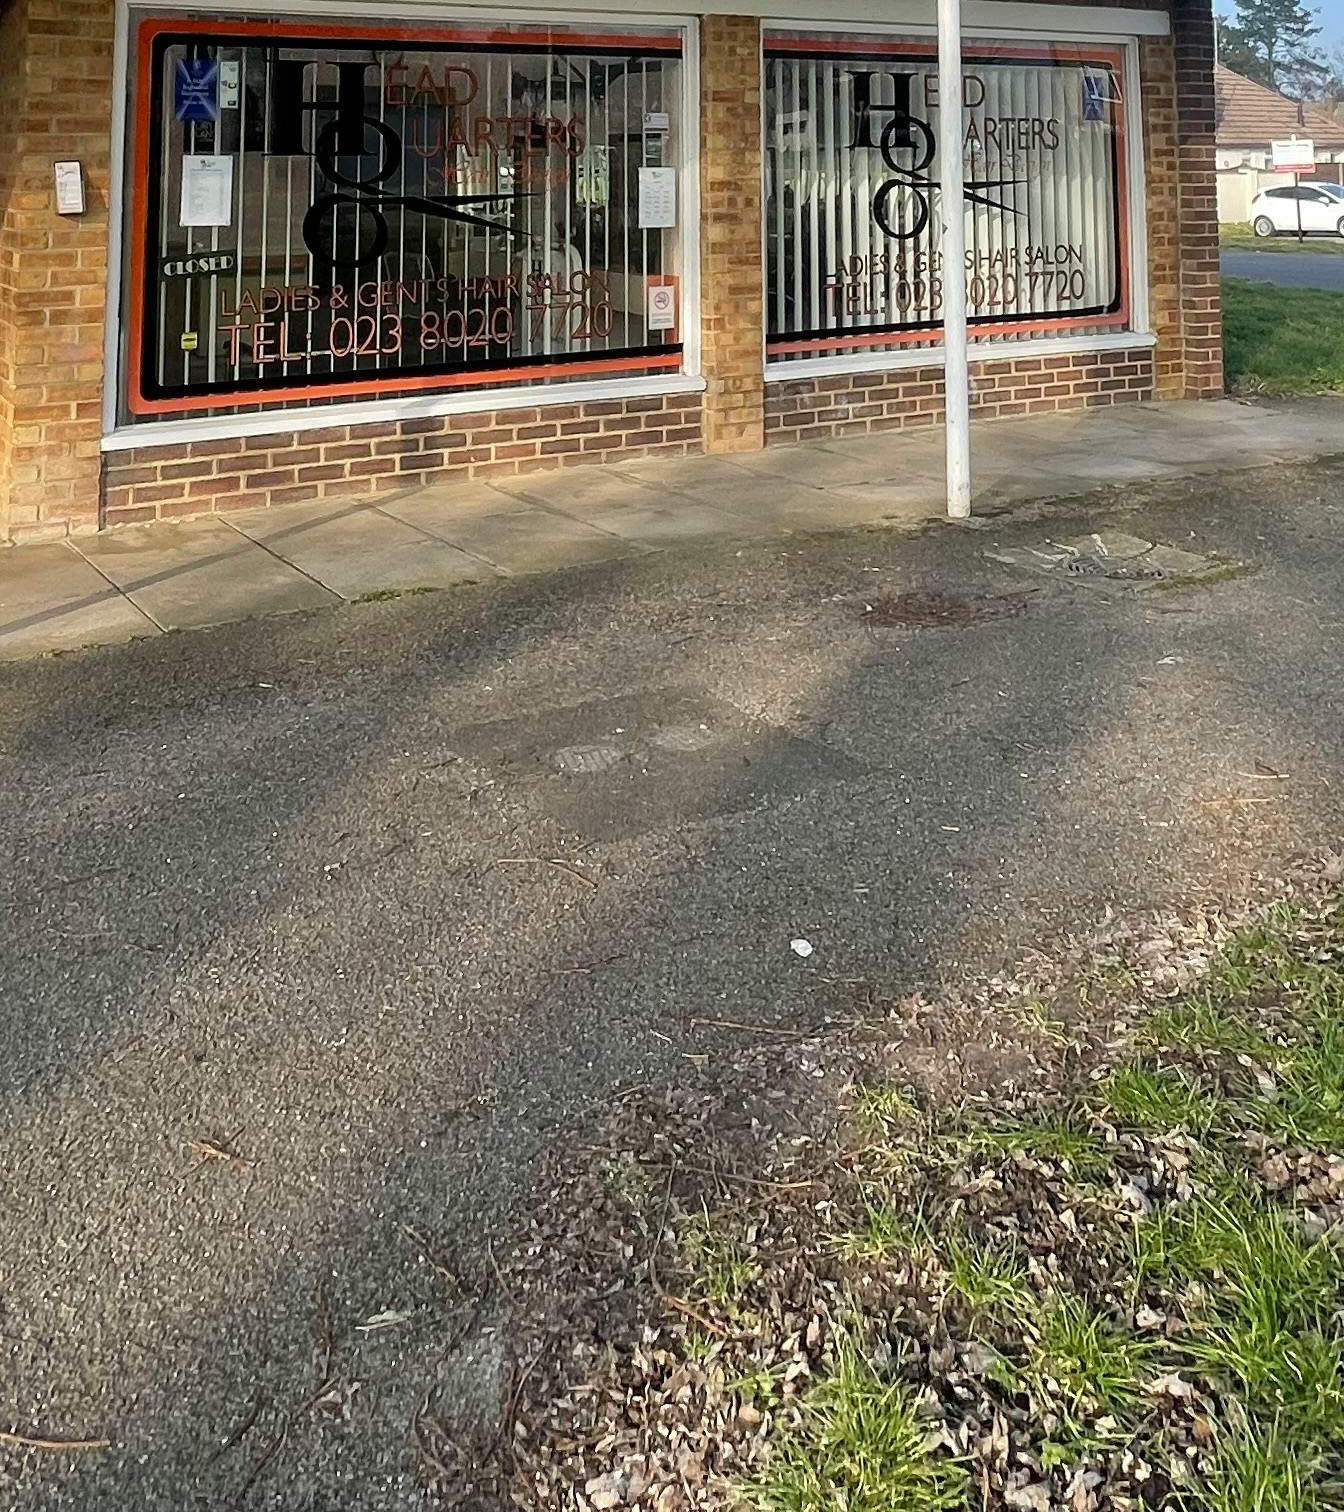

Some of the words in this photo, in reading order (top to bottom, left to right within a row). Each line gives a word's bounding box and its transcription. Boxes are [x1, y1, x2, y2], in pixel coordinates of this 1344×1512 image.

[163, 255, 234, 277] CLOSED
[894, 253, 907, 273] &
[977, 246, 1021, 270] HAIR
[1025, 244, 1084, 265] SALON
[221, 284, 321, 317] LADIES
[329, 284, 349, 311] &
[358, 276, 449, 308] GENTS
[458, 274, 521, 301] HAIR
[526, 270, 611, 298] SALON
[823, 281, 887, 317] TEL:
[895, 276, 944, 313] 023
[965, 271, 1018, 307] 020
[1024, 268, 1085, 303] 7720
[217, 320, 312, 366] TEL:
[329, 313, 403, 355] 023
[419, 305, 514, 350] 8020
[525, 300, 614, 343] 7720
